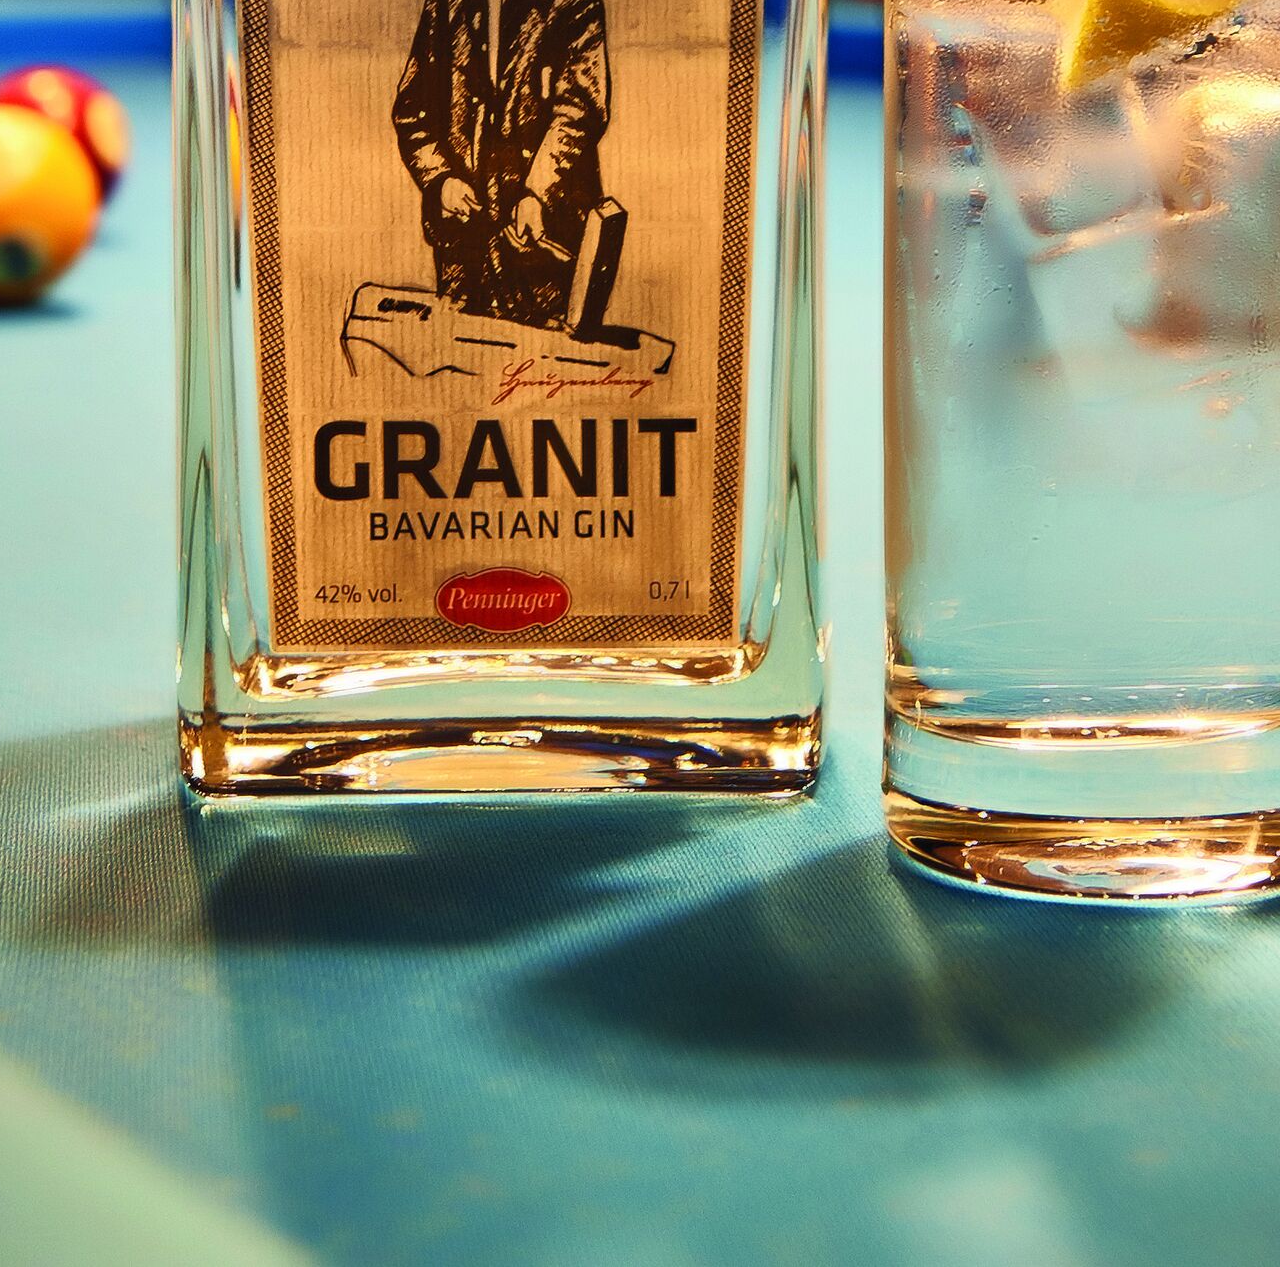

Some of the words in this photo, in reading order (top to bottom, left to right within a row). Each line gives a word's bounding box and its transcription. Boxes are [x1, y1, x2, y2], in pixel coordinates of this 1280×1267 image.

[313, 417, 698, 501] GRANIT
[369, 509, 560, 542] BAVARIAN
[573, 508, 635, 540] GIN
[314, 584, 362, 605] 42%
[367, 583, 403, 604] vol.
[446, 586, 562, 615] Penninger
[648, 580, 679, 603] 0,7
